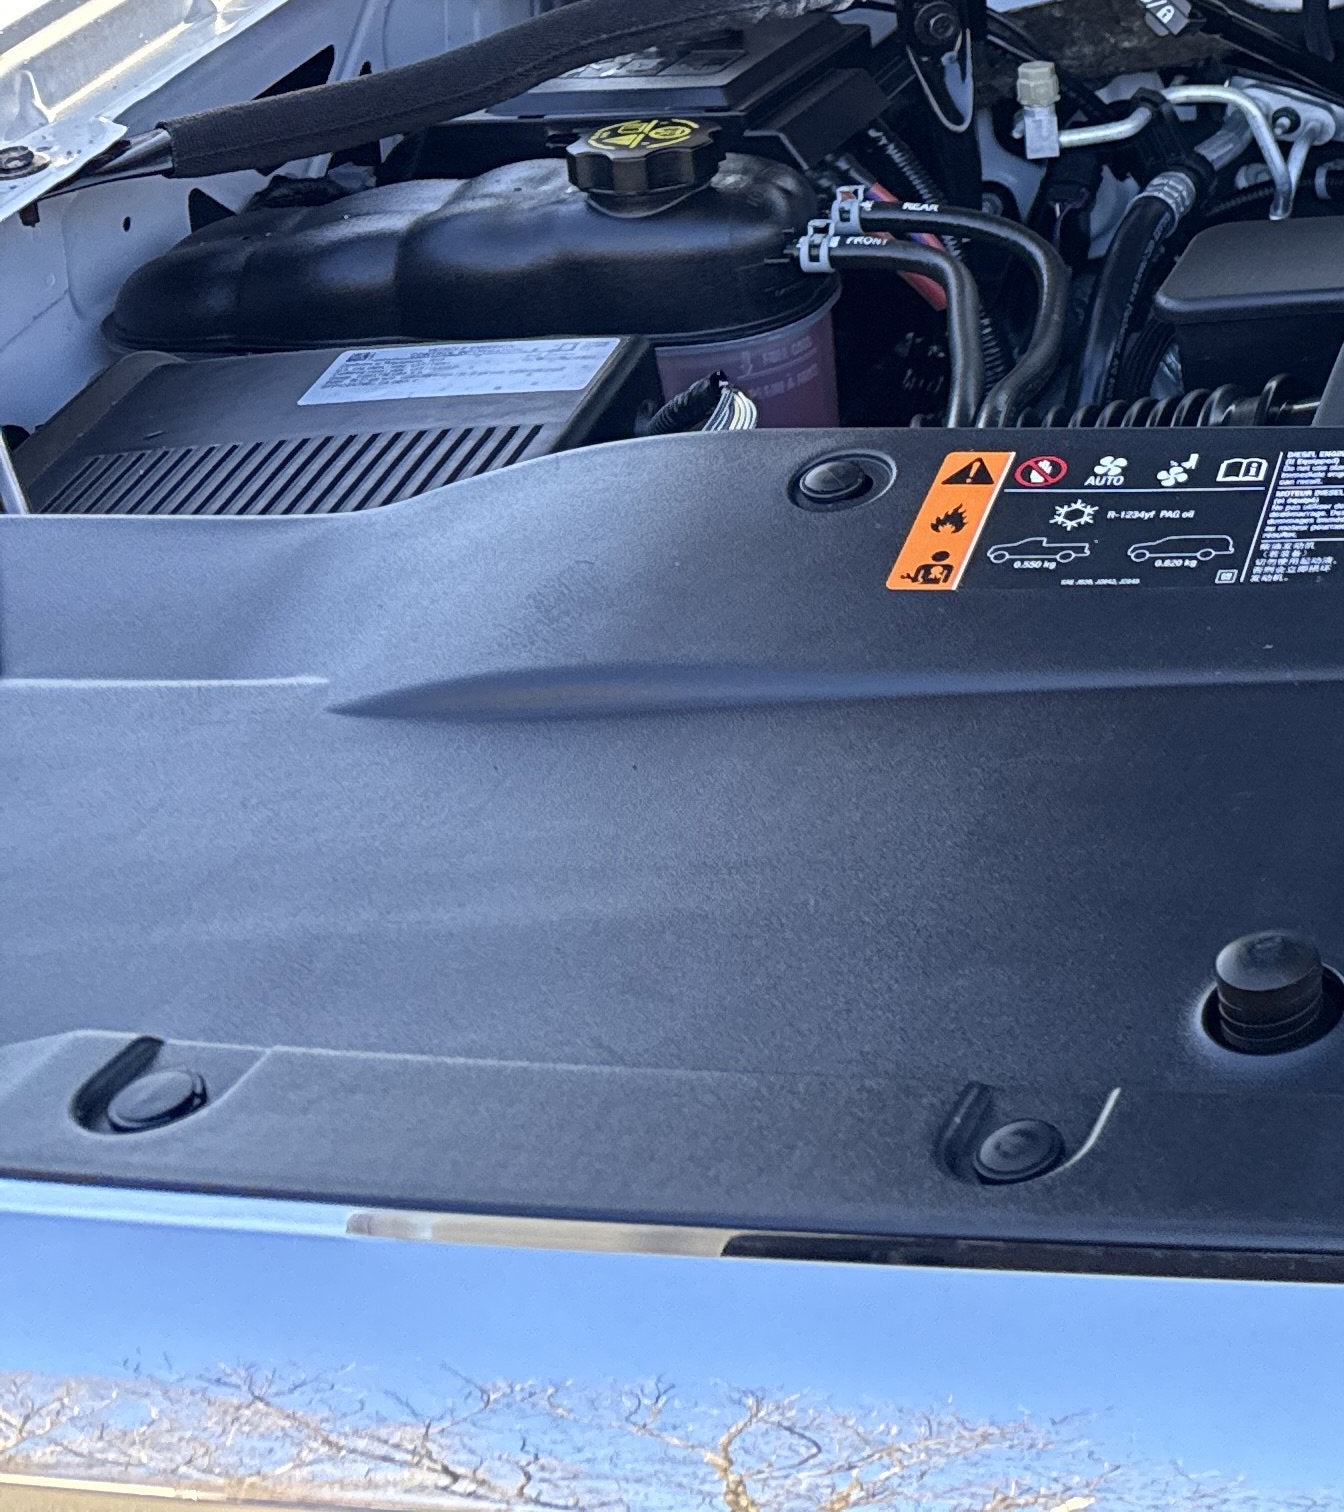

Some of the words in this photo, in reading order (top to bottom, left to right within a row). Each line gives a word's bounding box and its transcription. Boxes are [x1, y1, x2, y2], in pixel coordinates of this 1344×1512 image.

[902, 202, 939, 212] REAR
[845, 236, 888, 245] FRONT
[1084, 476, 1125, 486] AUTO
[1107, 510, 1156, 520] R-1234yf
[1160, 510, 1180, 518] PAG
[1181, 510, 1195, 518] oil
[1013, 560, 1042, 568] 0.550
[1043, 560, 1057, 570] kg
[1183, 559, 1198, 568] kg
